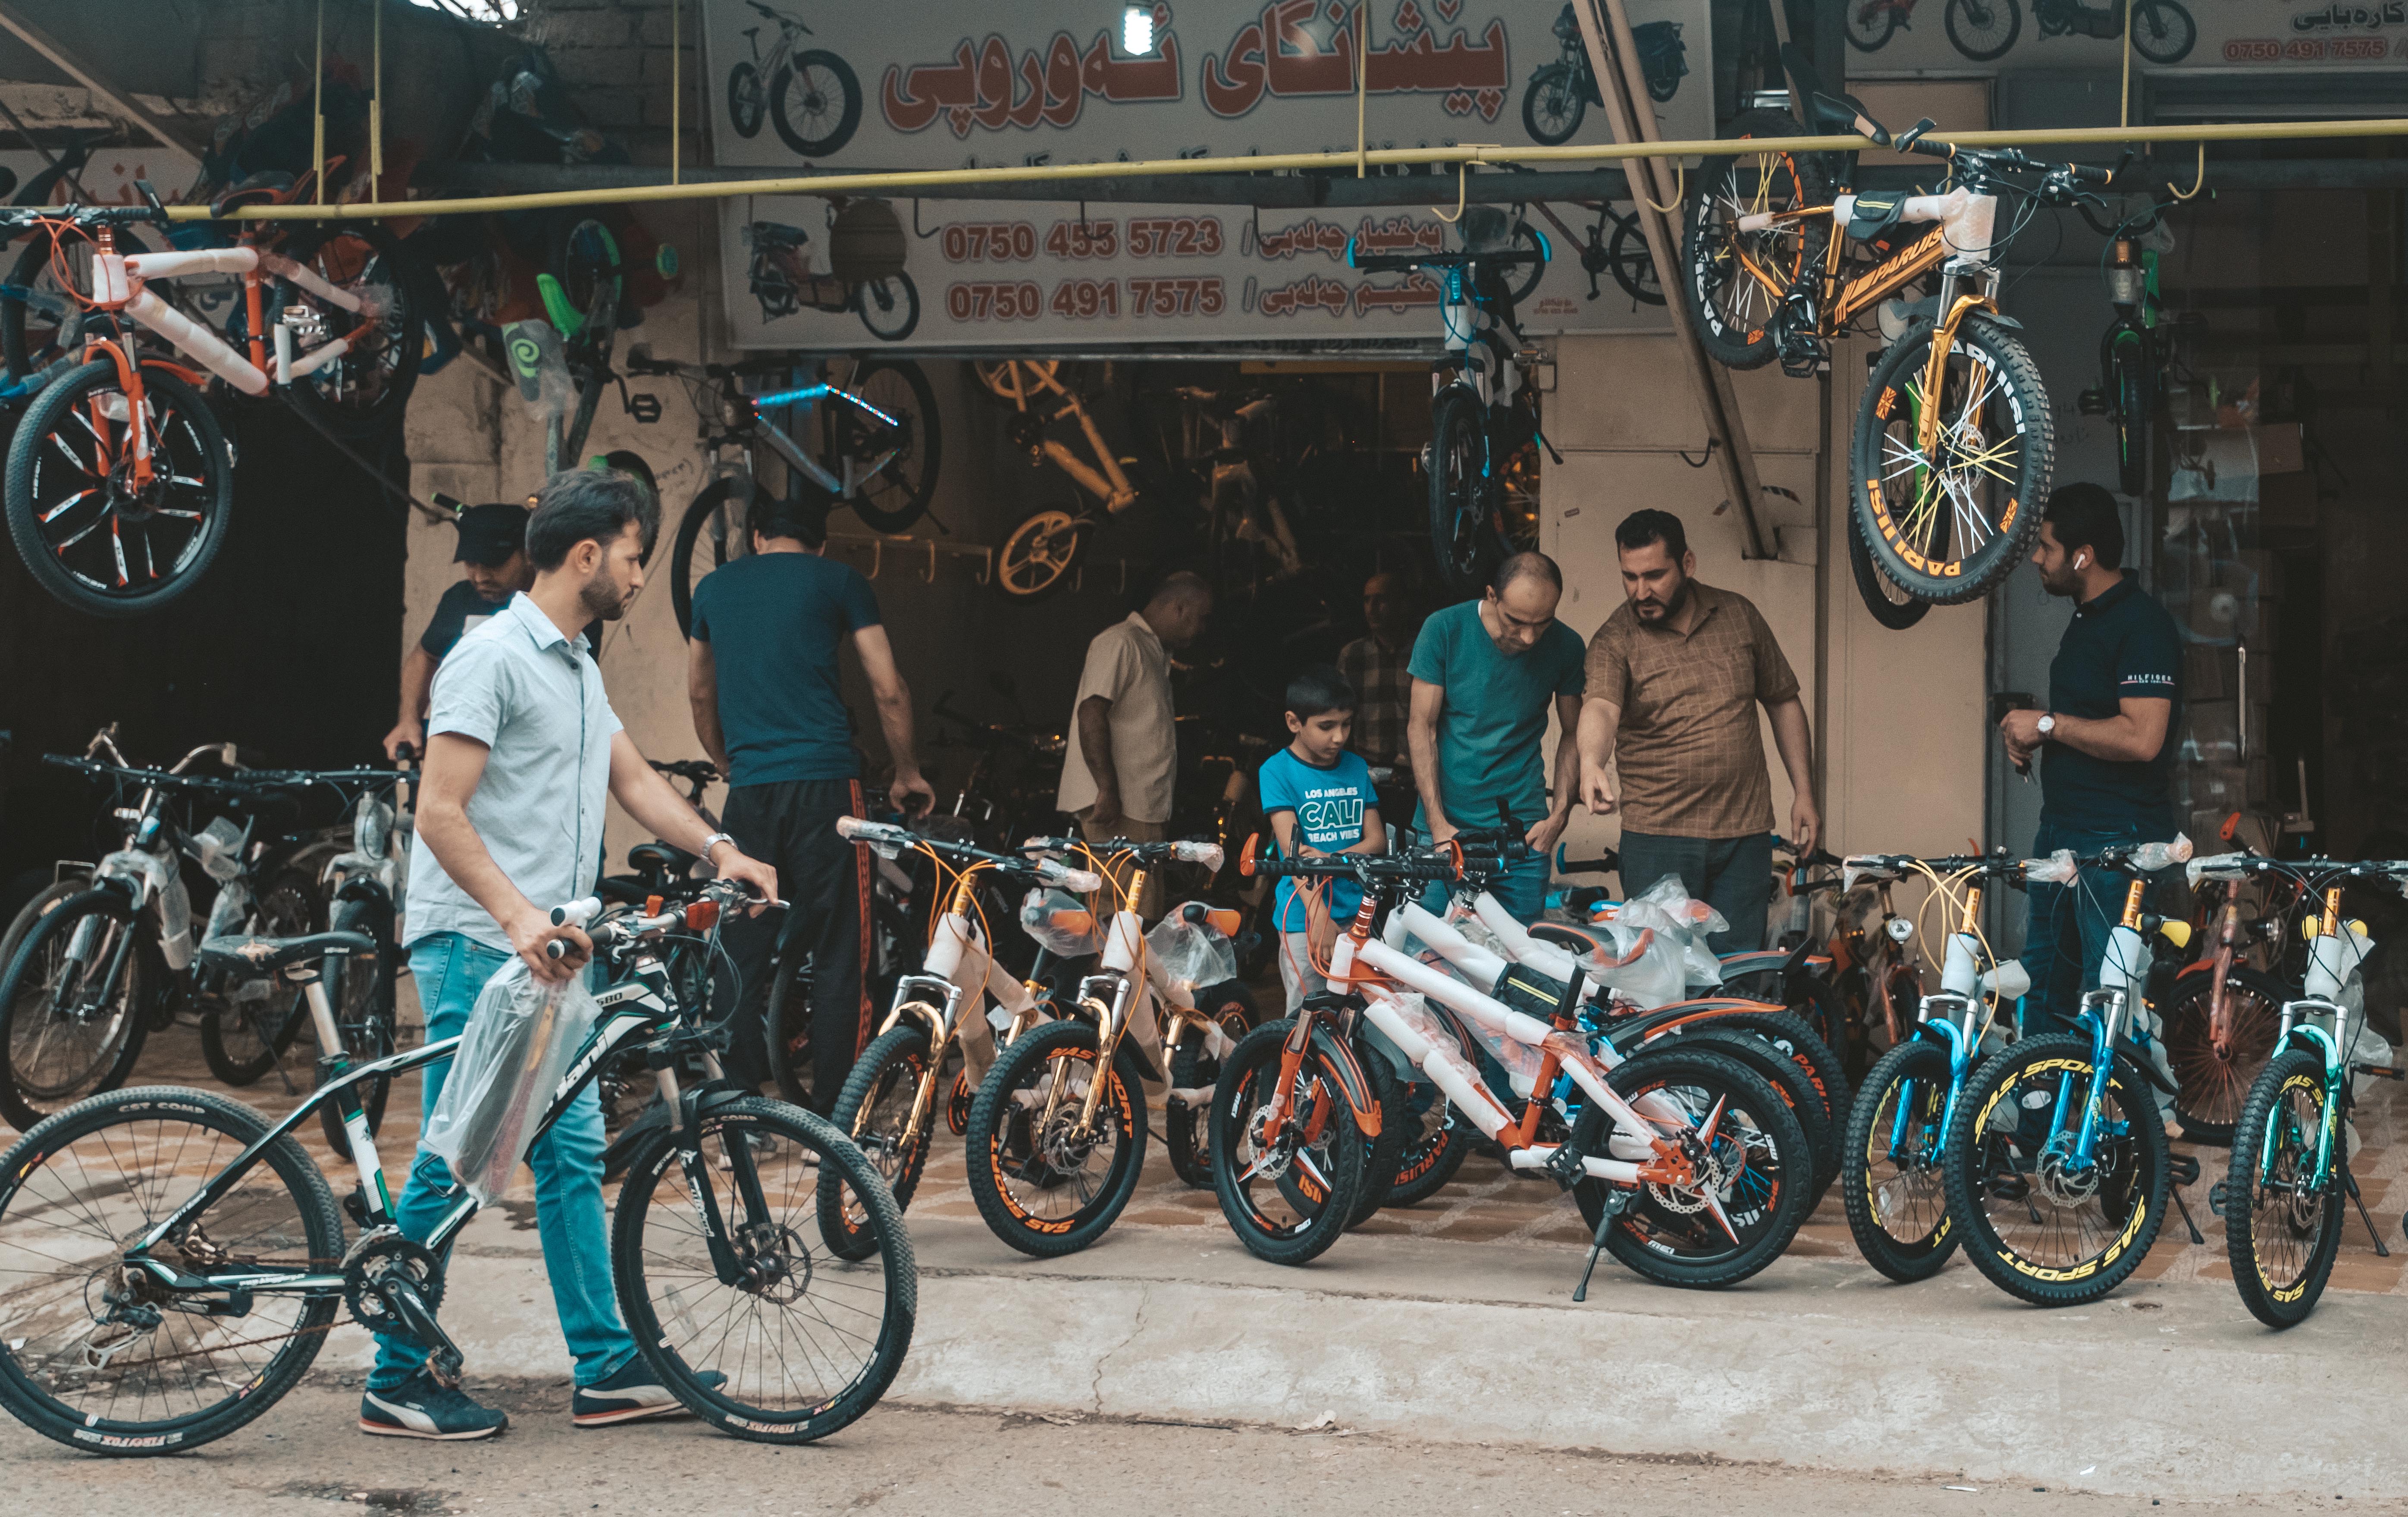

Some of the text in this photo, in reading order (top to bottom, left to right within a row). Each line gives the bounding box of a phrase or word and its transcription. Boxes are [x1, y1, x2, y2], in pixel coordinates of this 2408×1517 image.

[2225, 42, 2281, 59] 0750
[2286, 42, 2324, 59] 491
[2332, 38, 2387, 58] 7575
[944, 220, 1222, 260] 0750 455 5723
[950, 280, 1223, 319] 0750 491 7575
[1305, 787, 1358, 799] LOS ANGELES
[1299, 798, 1363, 831] CALI
[1307, 832, 1337, 842] BEACH
[157, 1102, 205, 1114] COMP
[1997, 1250, 2098, 1282] SPORT
